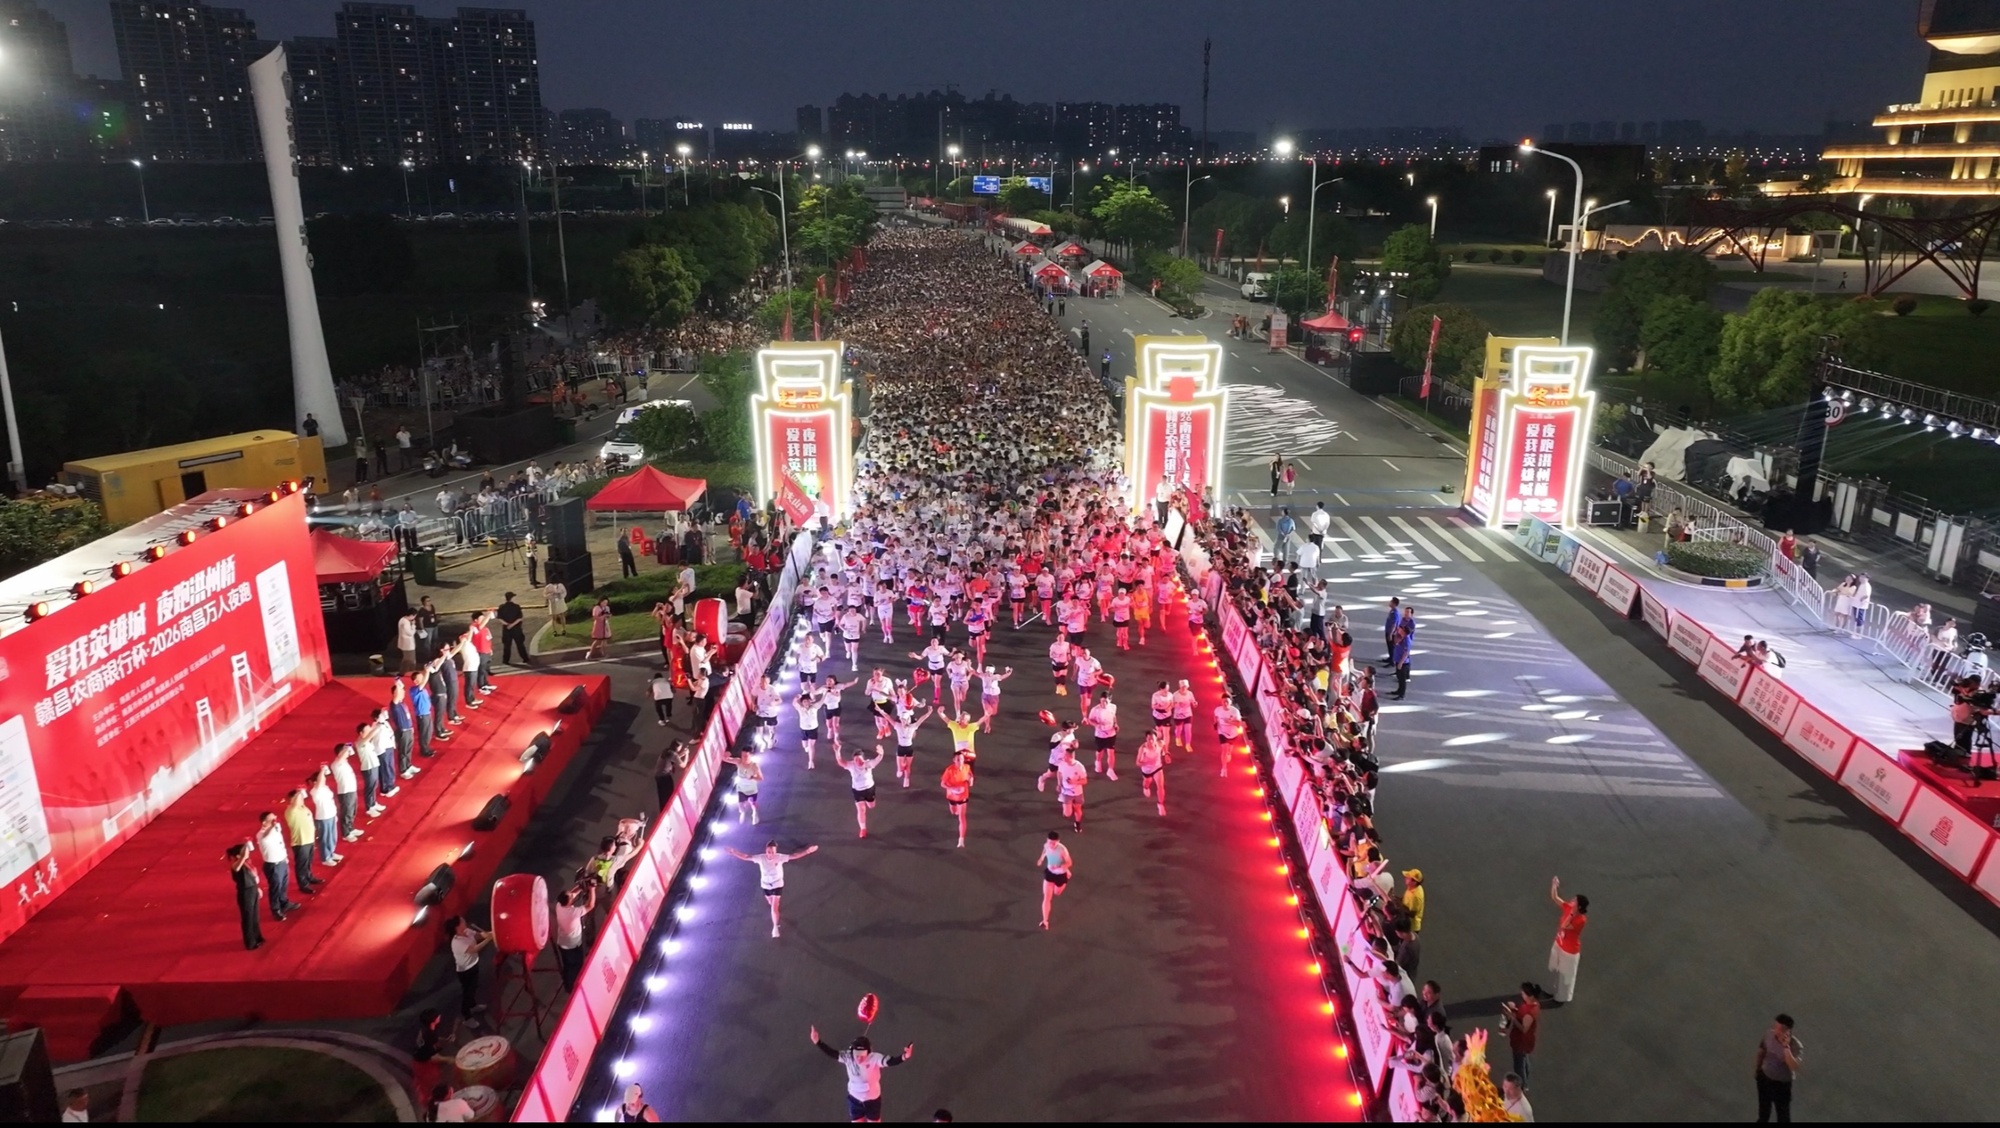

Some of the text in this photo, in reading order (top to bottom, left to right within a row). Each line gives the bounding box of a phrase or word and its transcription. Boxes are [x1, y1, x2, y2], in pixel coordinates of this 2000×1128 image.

[46, 602, 146, 690] 爱我英雄城
